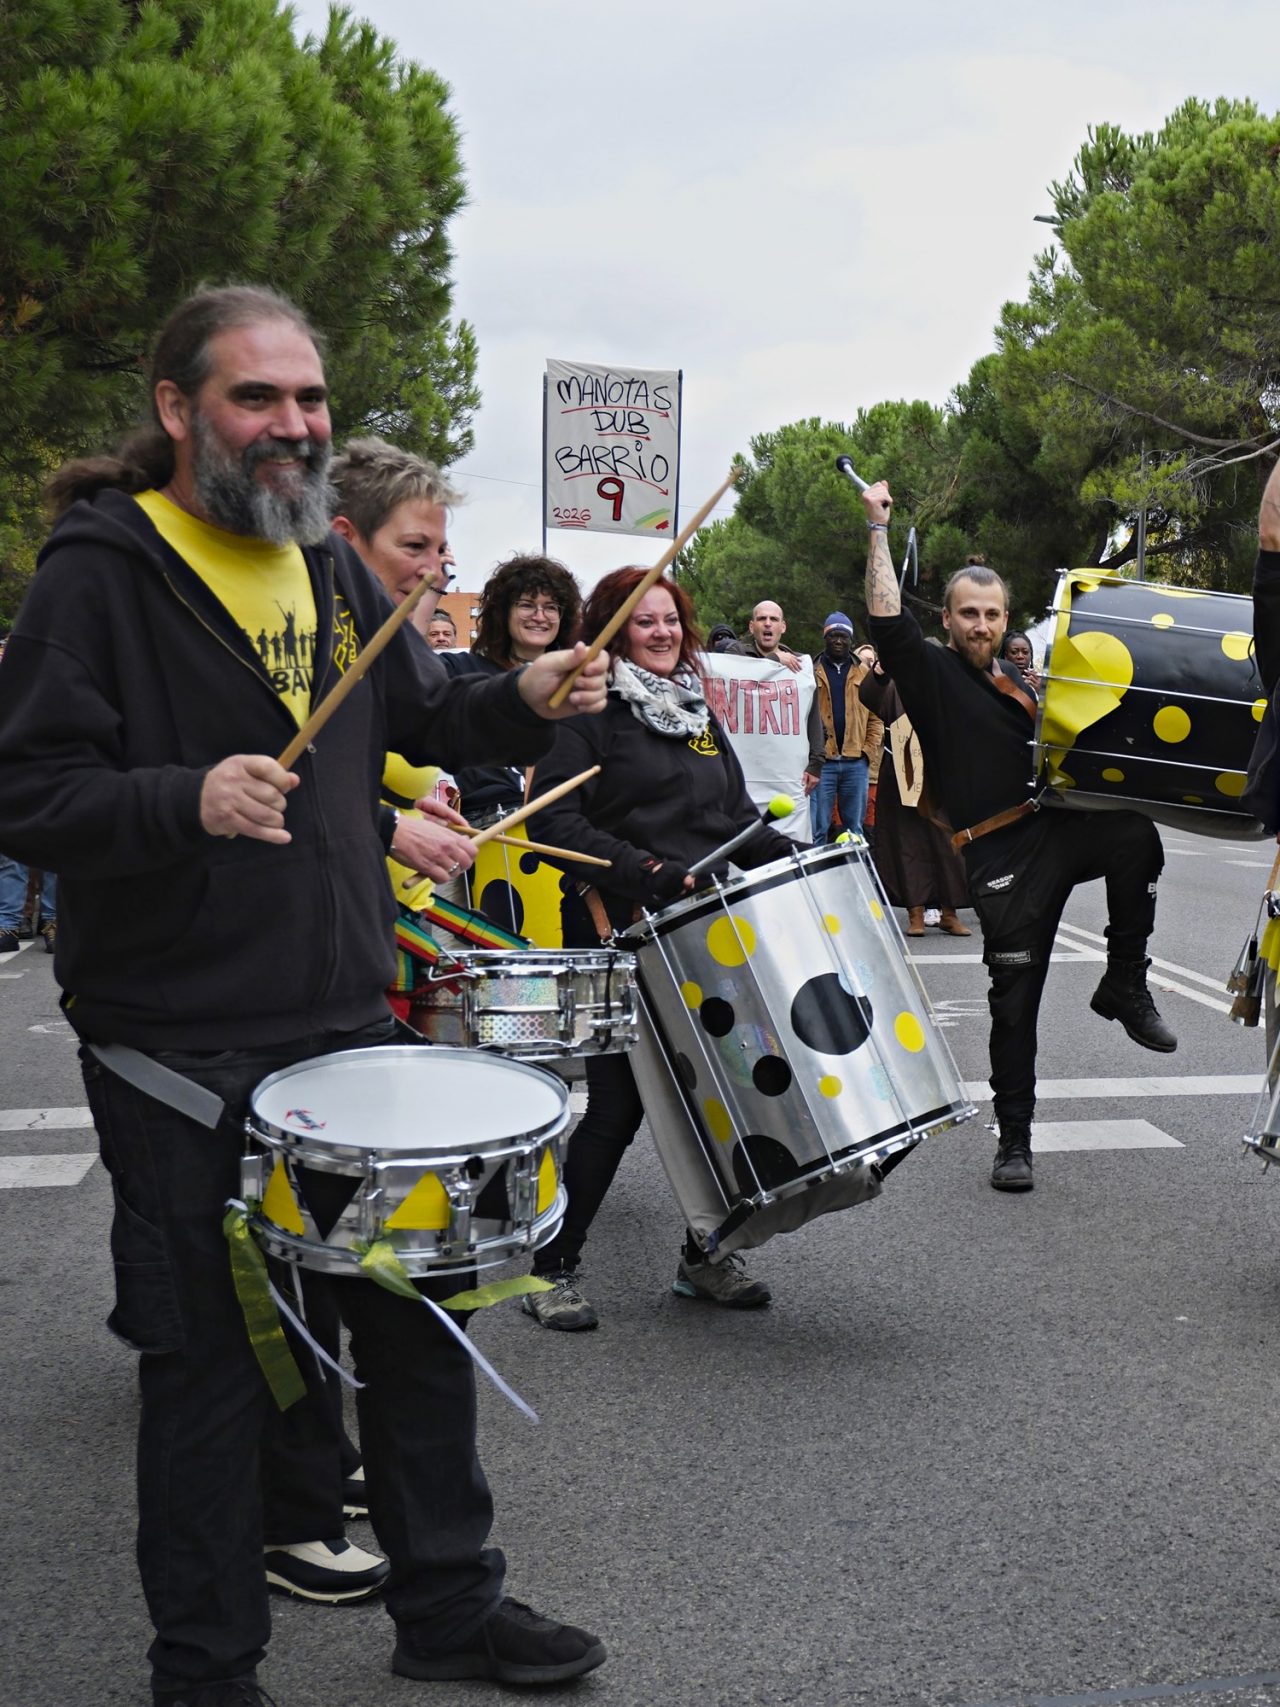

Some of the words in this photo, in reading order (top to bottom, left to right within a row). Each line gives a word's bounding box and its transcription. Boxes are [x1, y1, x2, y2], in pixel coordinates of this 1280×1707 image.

[557, 373, 672, 411] MANOTAS
[590, 410, 650, 434] DUB
[553, 507, 592, 521] 2026
[597, 477, 625, 521] 9
